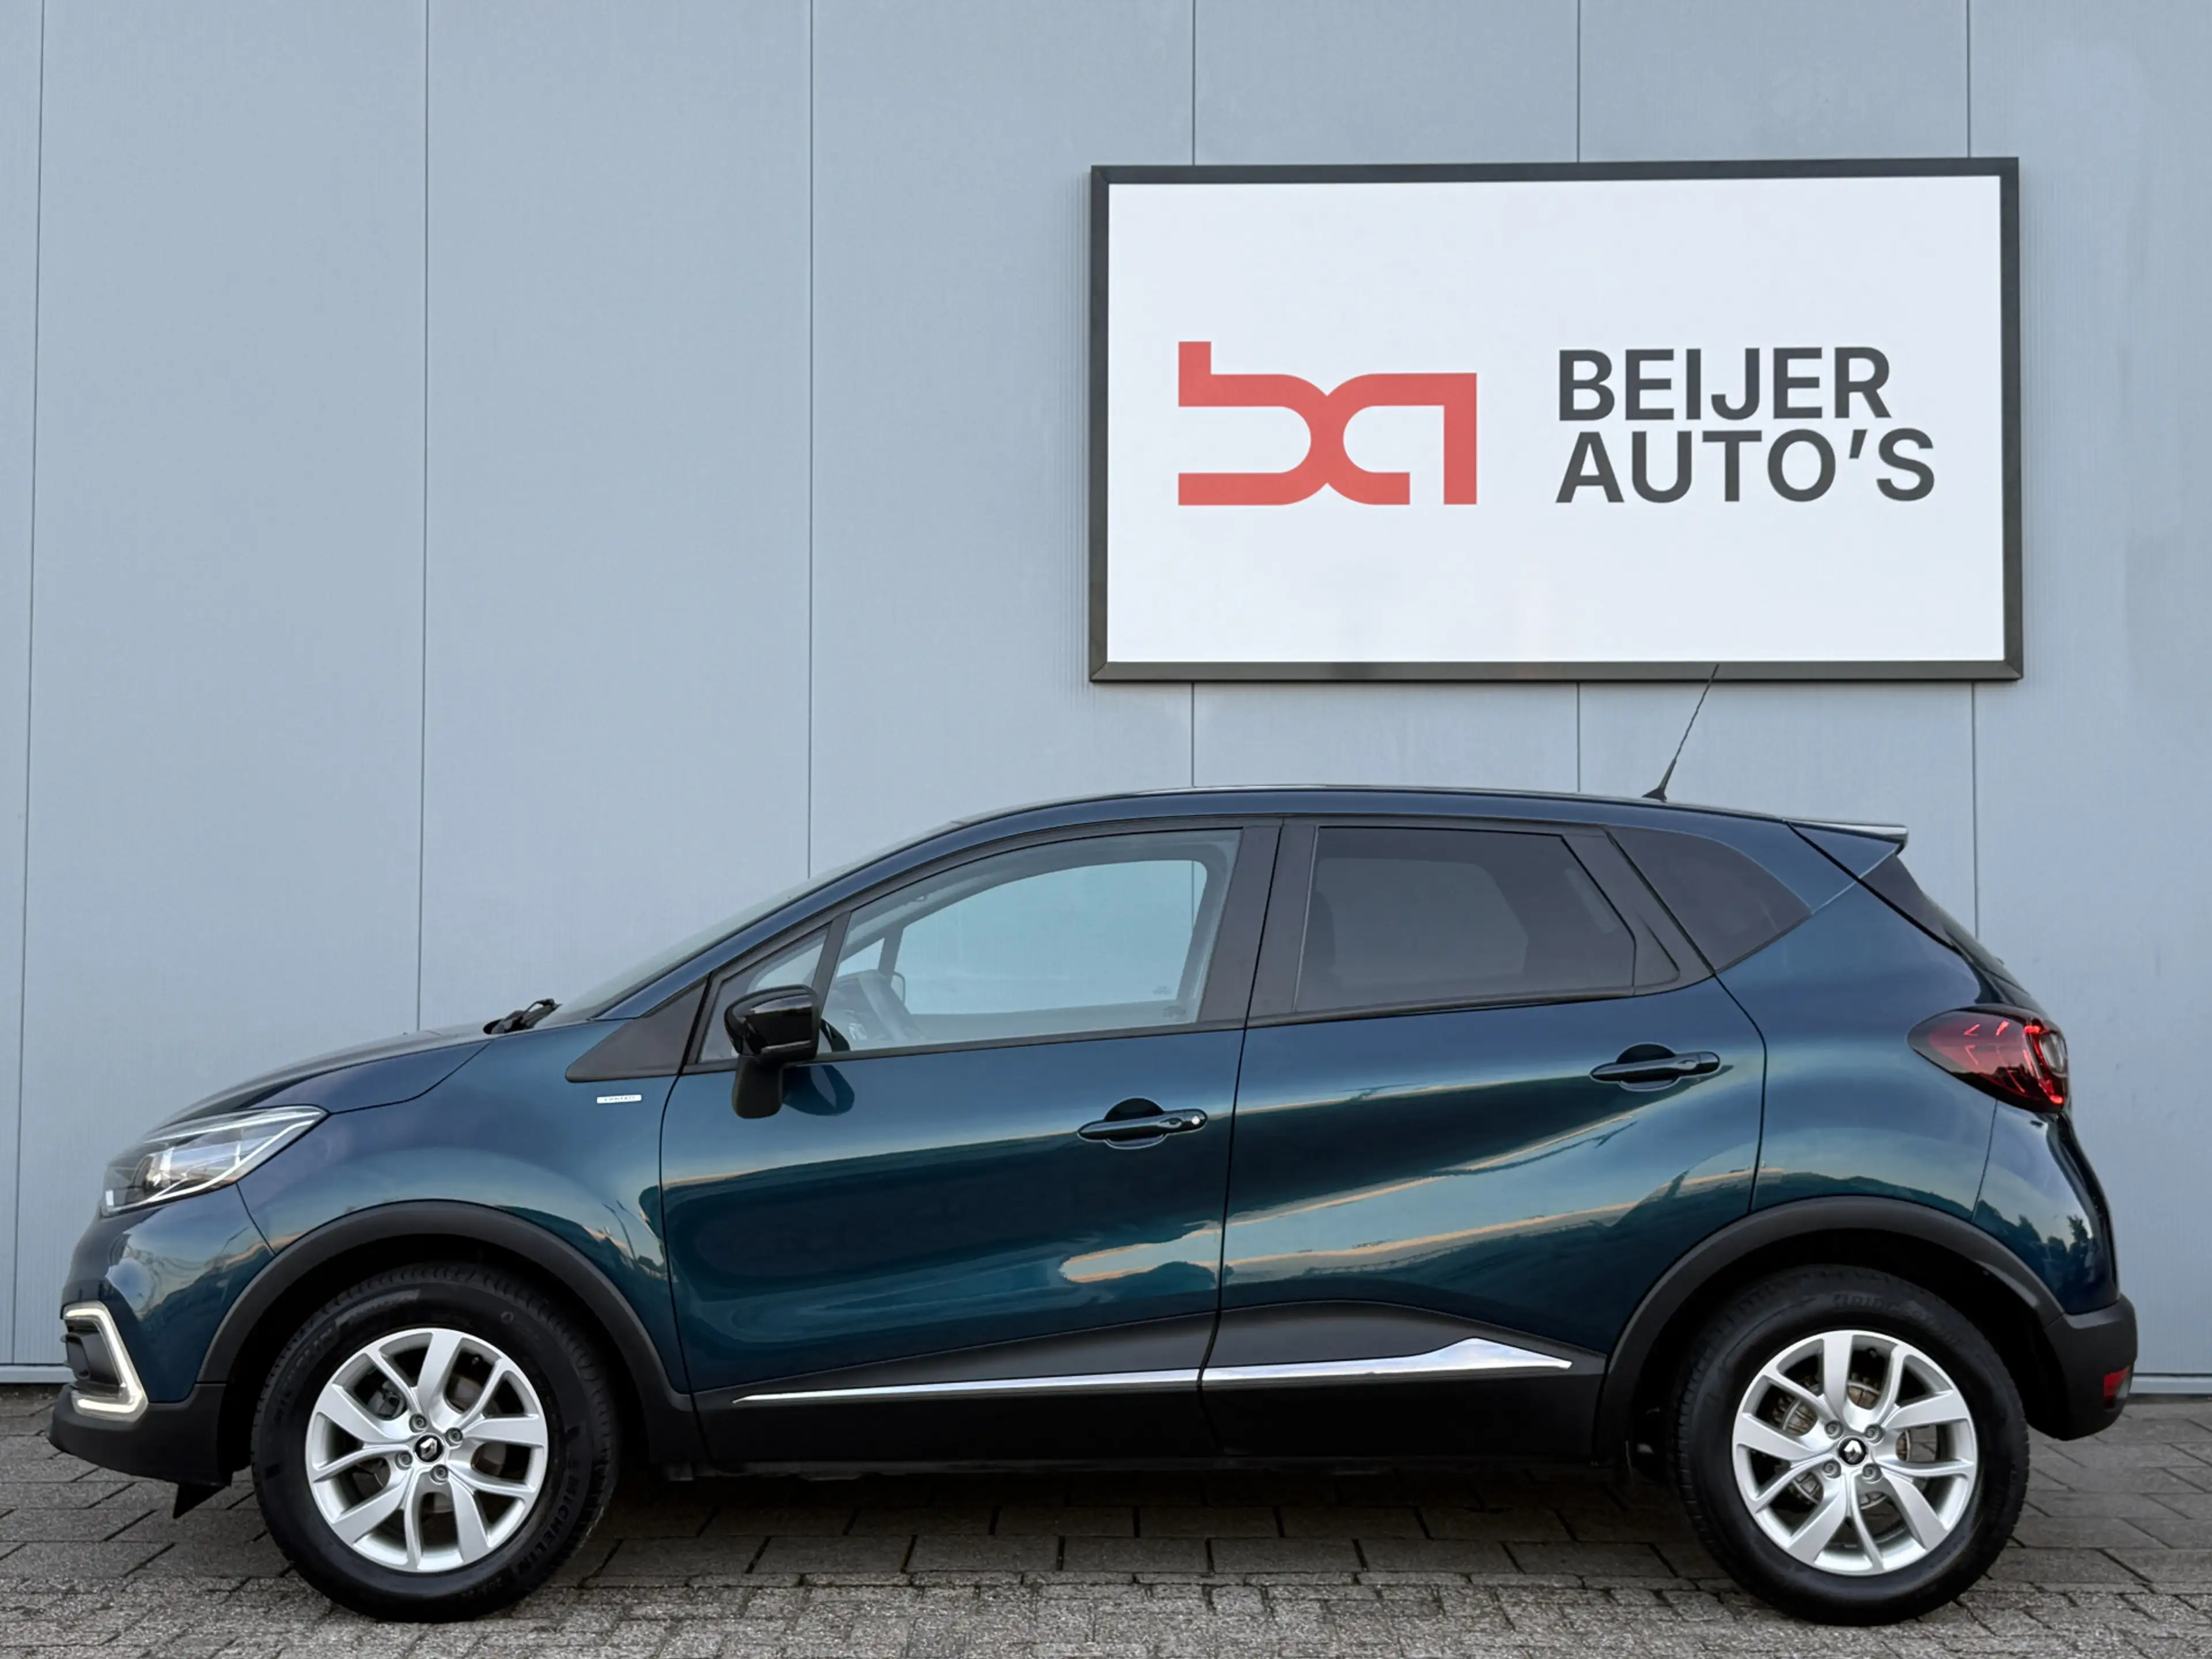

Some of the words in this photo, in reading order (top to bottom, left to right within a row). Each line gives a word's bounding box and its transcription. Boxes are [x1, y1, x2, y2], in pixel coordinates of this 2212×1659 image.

[1560, 347, 1891, 421] BEIJER
[1556, 429, 1934, 503] AUTO’S
[519, 1474, 579, 1573] MICHELIN
